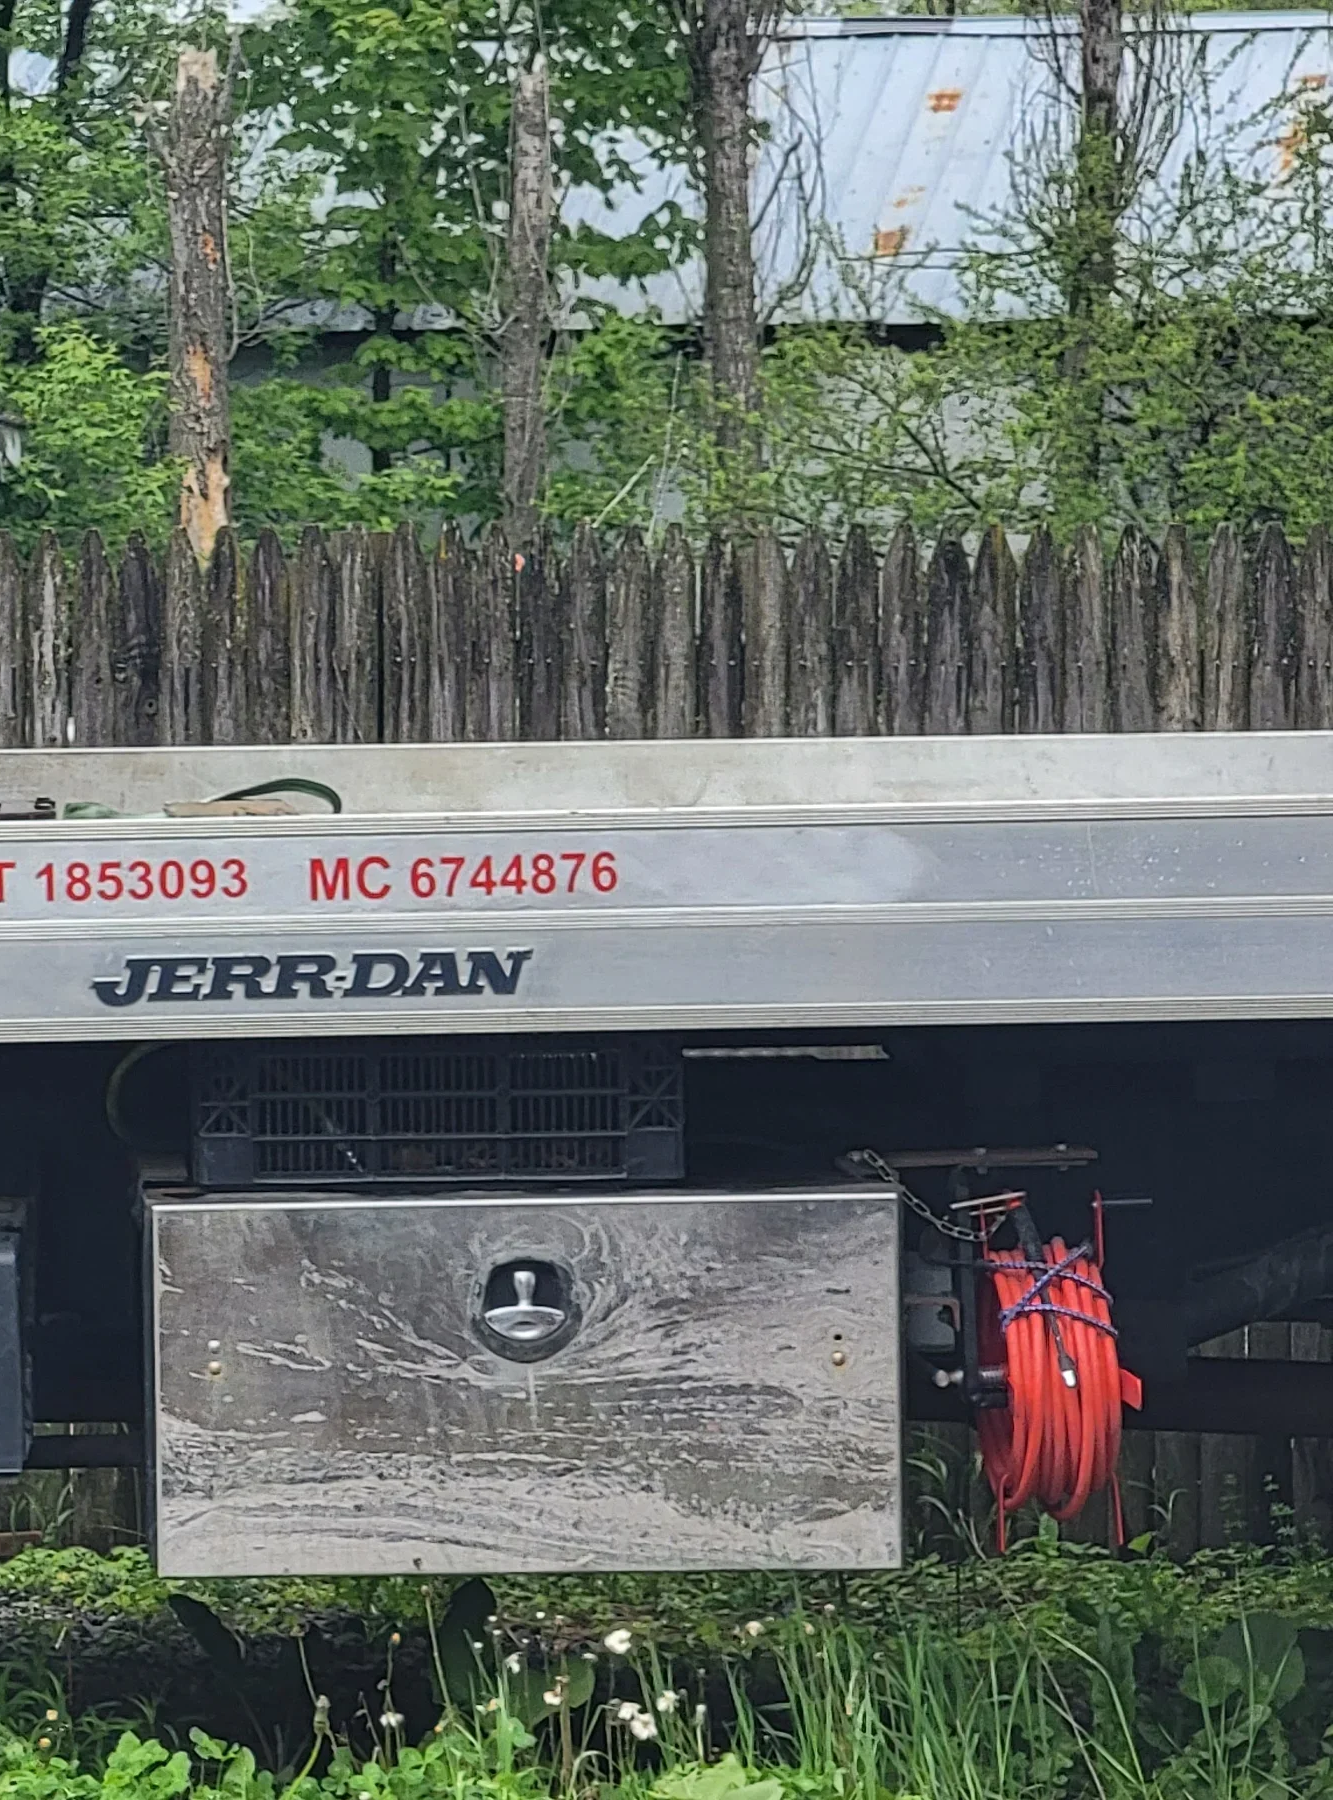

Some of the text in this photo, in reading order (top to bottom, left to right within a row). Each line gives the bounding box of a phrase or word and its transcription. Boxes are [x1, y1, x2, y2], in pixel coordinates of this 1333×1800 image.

[33, 858, 250, 902] 1853093
[308, 855, 392, 901] MC
[409, 850, 619, 899] 6744876
[90, 947, 536, 1008] JERR-DAN
